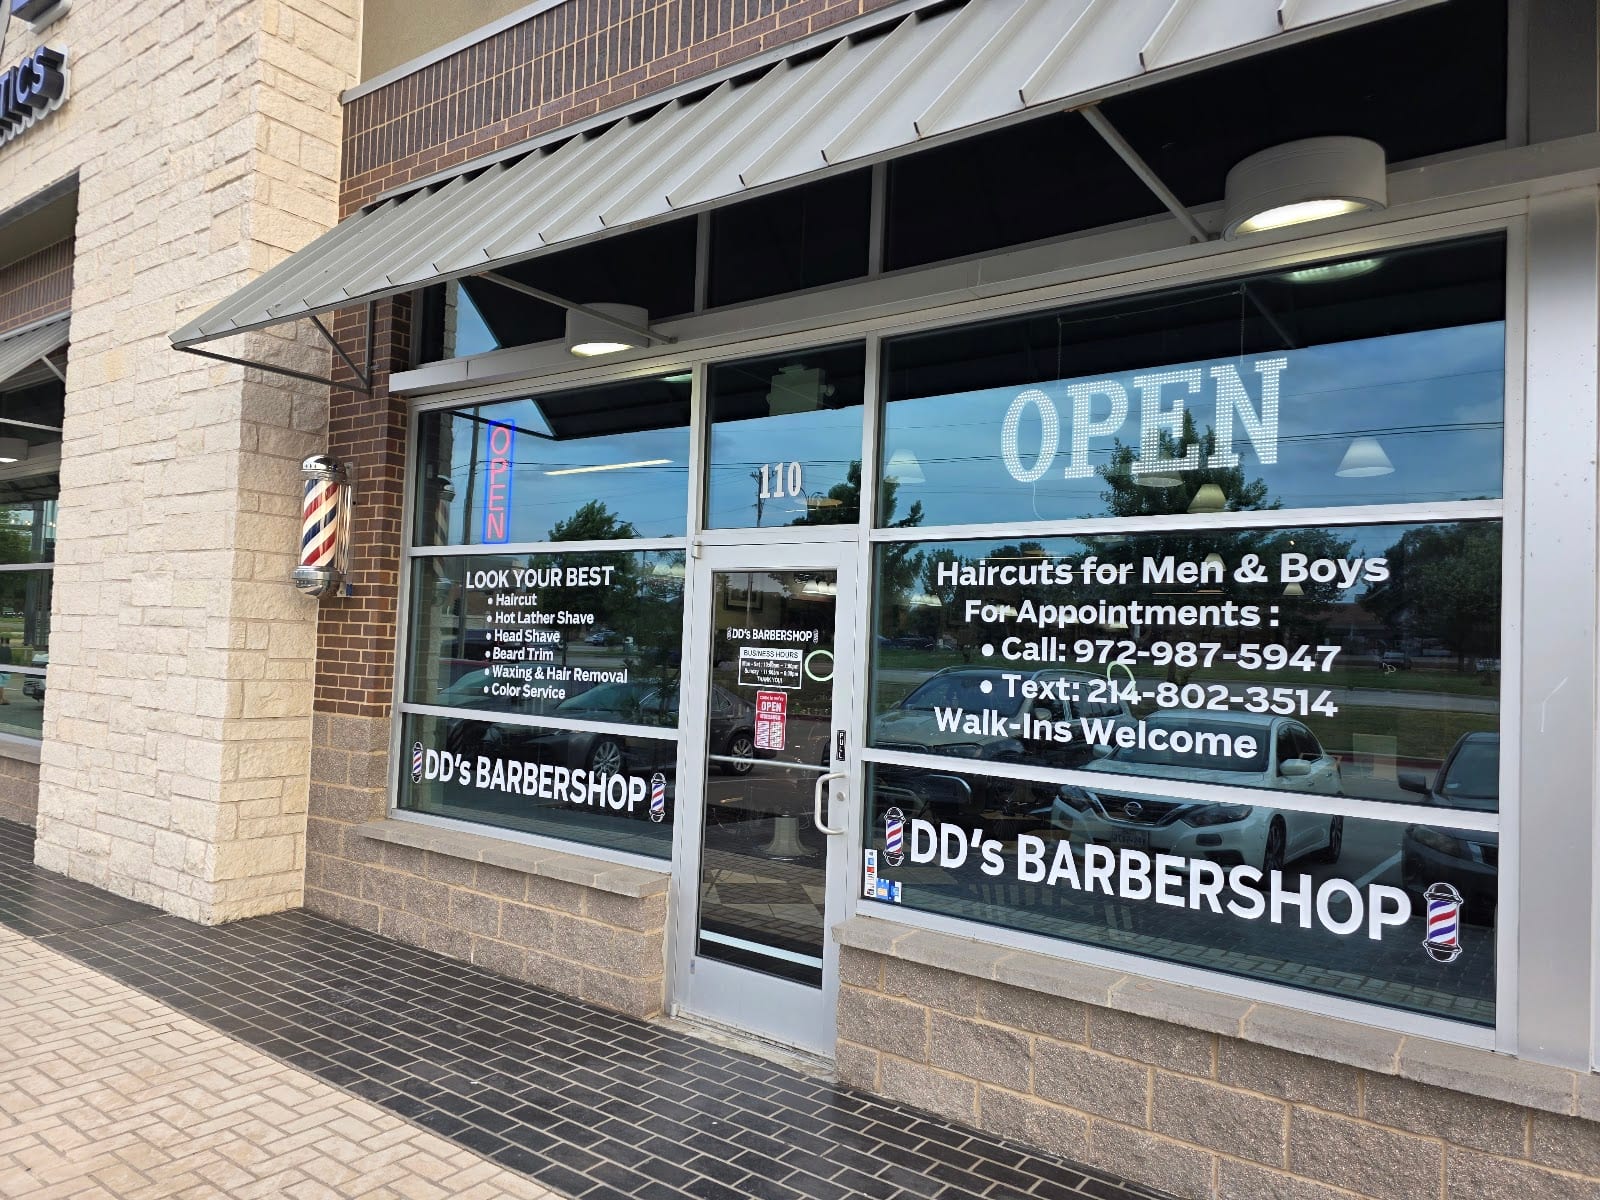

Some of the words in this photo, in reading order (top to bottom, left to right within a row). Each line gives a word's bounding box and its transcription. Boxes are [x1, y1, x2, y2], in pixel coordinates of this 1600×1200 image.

[1000, 357, 1288, 483] OPEN
[487, 426, 511, 539] OPEN
[759, 461, 802, 499] 110
[466, 569, 511, 589] LOOK
[513, 568, 562, 588] YOUR
[566, 565, 615, 587] BEST
[936, 561, 1073, 587] Haircuts
[1081, 556, 1134, 584] for
[1143, 555, 1225, 584] Men
[1234, 554, 1269, 583] &
[1280, 553, 1391, 589] Boys
[496, 593, 537, 606] Haircut
[495, 611, 515, 624] Hot
[517, 611, 555, 624] Lather
[557, 611, 595, 625] Shave
[965, 600, 1009, 623] For
[1016, 600, 1261, 628] Appointments
[494, 629, 524, 643] Head
[525, 630, 561, 643] Shave
[752, 628, 813, 642] BARBERSHOP
[492, 648, 525, 661] Beard
[527, 649, 554, 661] Trim
[743, 649, 775, 658] BUSINESS
[775, 651, 799, 659] HOURS
[1001, 637, 1066, 662] Call:
[1073, 640, 1342, 672] 972-987-5947
[492, 668, 533, 681] Waxing
[534, 670, 545, 680] &
[546, 669, 572, 682] Hair
[573, 669, 628, 684] Removal
[491, 684, 522, 696] Color
[522, 685, 566, 699] Service
[1001, 673, 1081, 702] Text:
[1088, 679, 1338, 717] 214-802-3514
[761, 701, 782, 712] OPEN
[934, 707, 1073, 743] Walk-Ins
[1080, 717, 1258, 758] Welcome
[424, 748, 471, 786] DD's
[476, 756, 647, 812] BARBERSHOP
[910, 819, 1004, 876] DD's
[1017, 834, 1412, 941] BARBERSHOP
